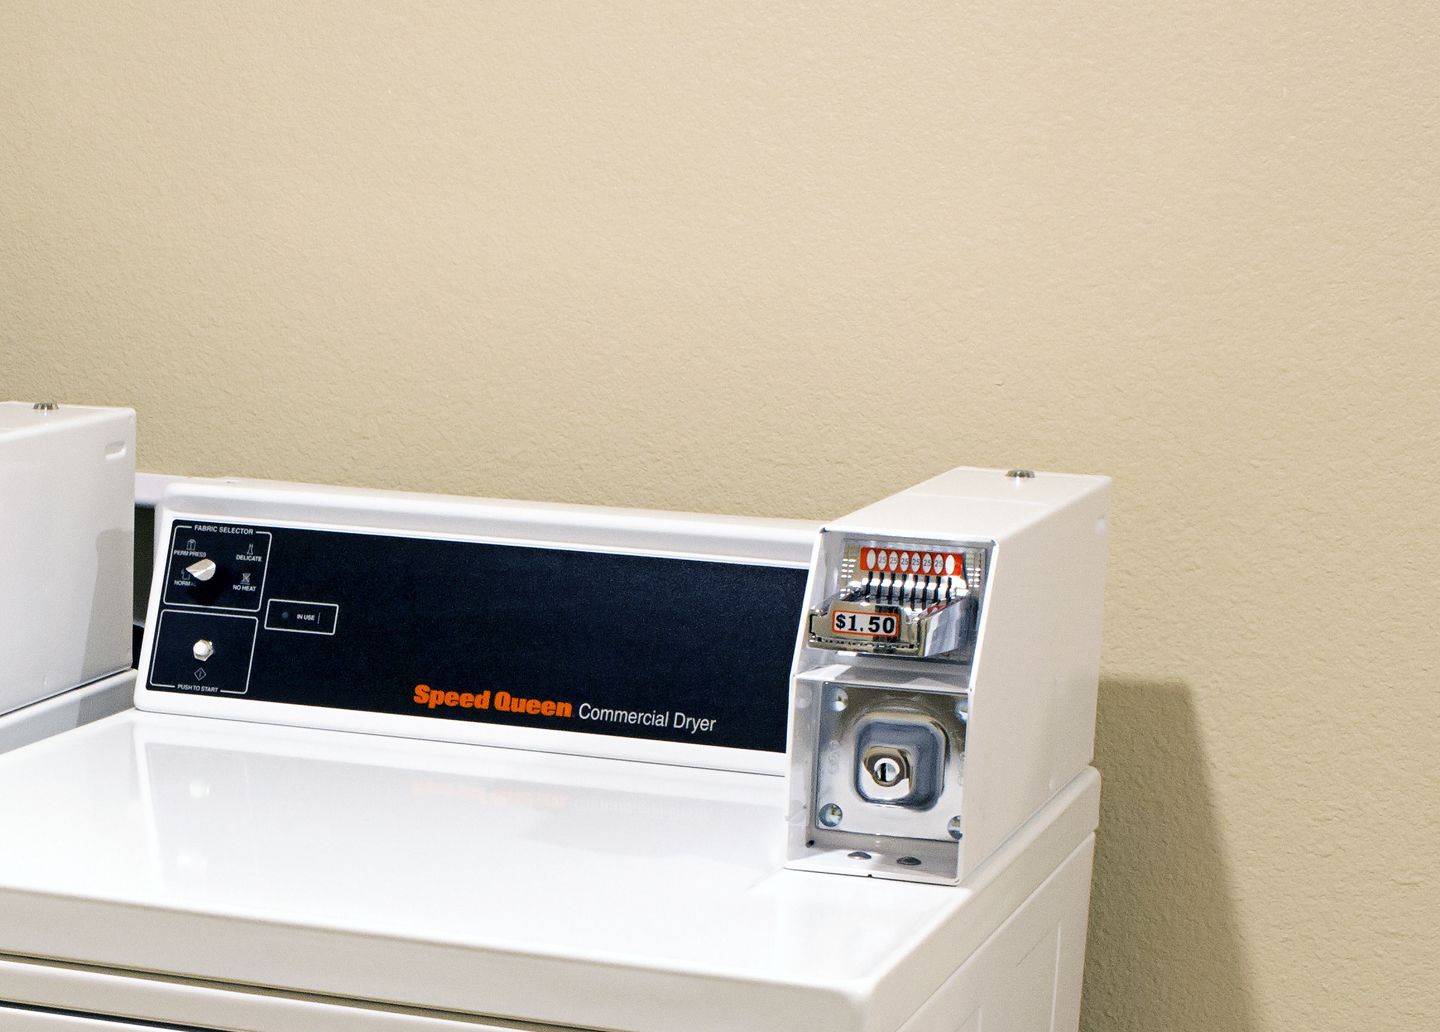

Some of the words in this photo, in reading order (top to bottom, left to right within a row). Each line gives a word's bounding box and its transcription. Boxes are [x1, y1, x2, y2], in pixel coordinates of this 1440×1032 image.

[194, 524, 218, 533] FABRIC
[219, 526, 254, 535] SELECTOR
[236, 554, 262, 562] DELICATE
[890, 556, 898, 564] 25
[901, 557, 909, 565] 25
[912, 558, 920, 566] 25
[923, 559, 932, 567] 25
[934, 560, 943, 568] 25
[835, 613, 895, 634] $1.50
[177, 683, 193, 691] PUSH
[413, 684, 491, 710] Speed
[494, 691, 573, 718] Queen
[578, 702, 669, 728] Commercial
[673, 712, 717, 735] Dryer
